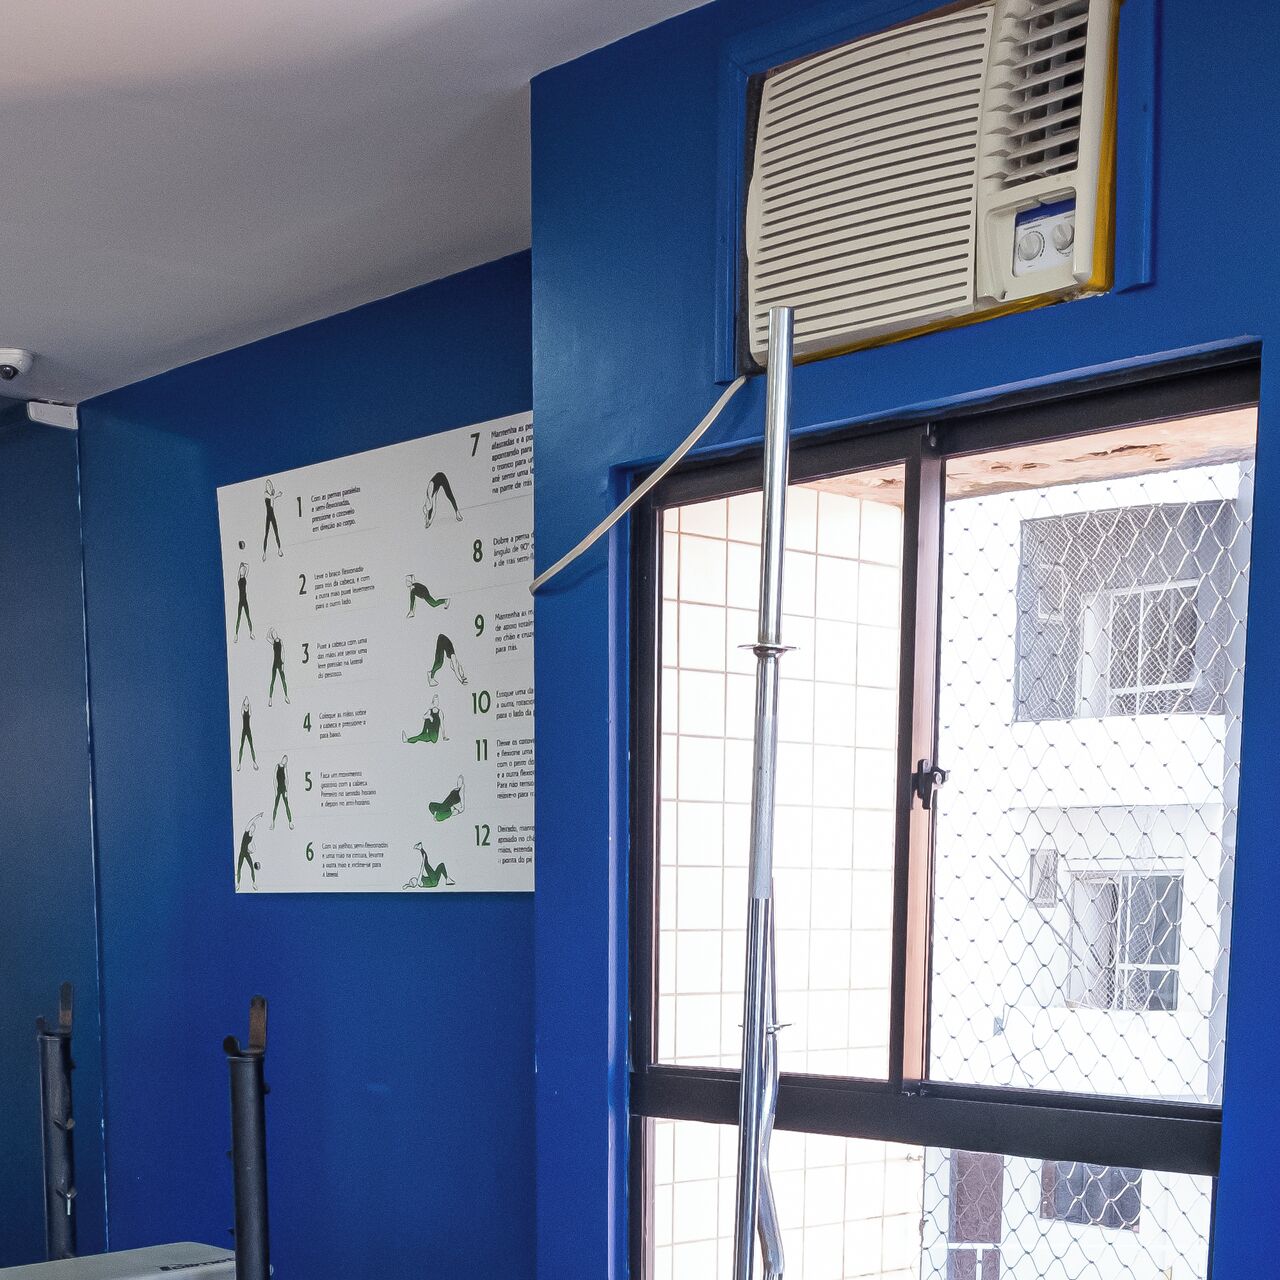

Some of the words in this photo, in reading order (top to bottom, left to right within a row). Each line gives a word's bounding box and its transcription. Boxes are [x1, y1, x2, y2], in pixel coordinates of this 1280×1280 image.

[470, 432, 480, 457] 7
[296, 497, 302, 517] 1
[473, 539, 483, 563] 8
[299, 573, 307, 595] 2
[474, 614, 485, 637] 9
[302, 643, 309, 664] 3
[472, 690, 491, 714] 10
[303, 712, 312, 732] 4
[476, 739, 487, 761] 11
[305, 772, 312, 791] 5
[475, 824, 490, 846] 12
[306, 841, 314, 861] 6
